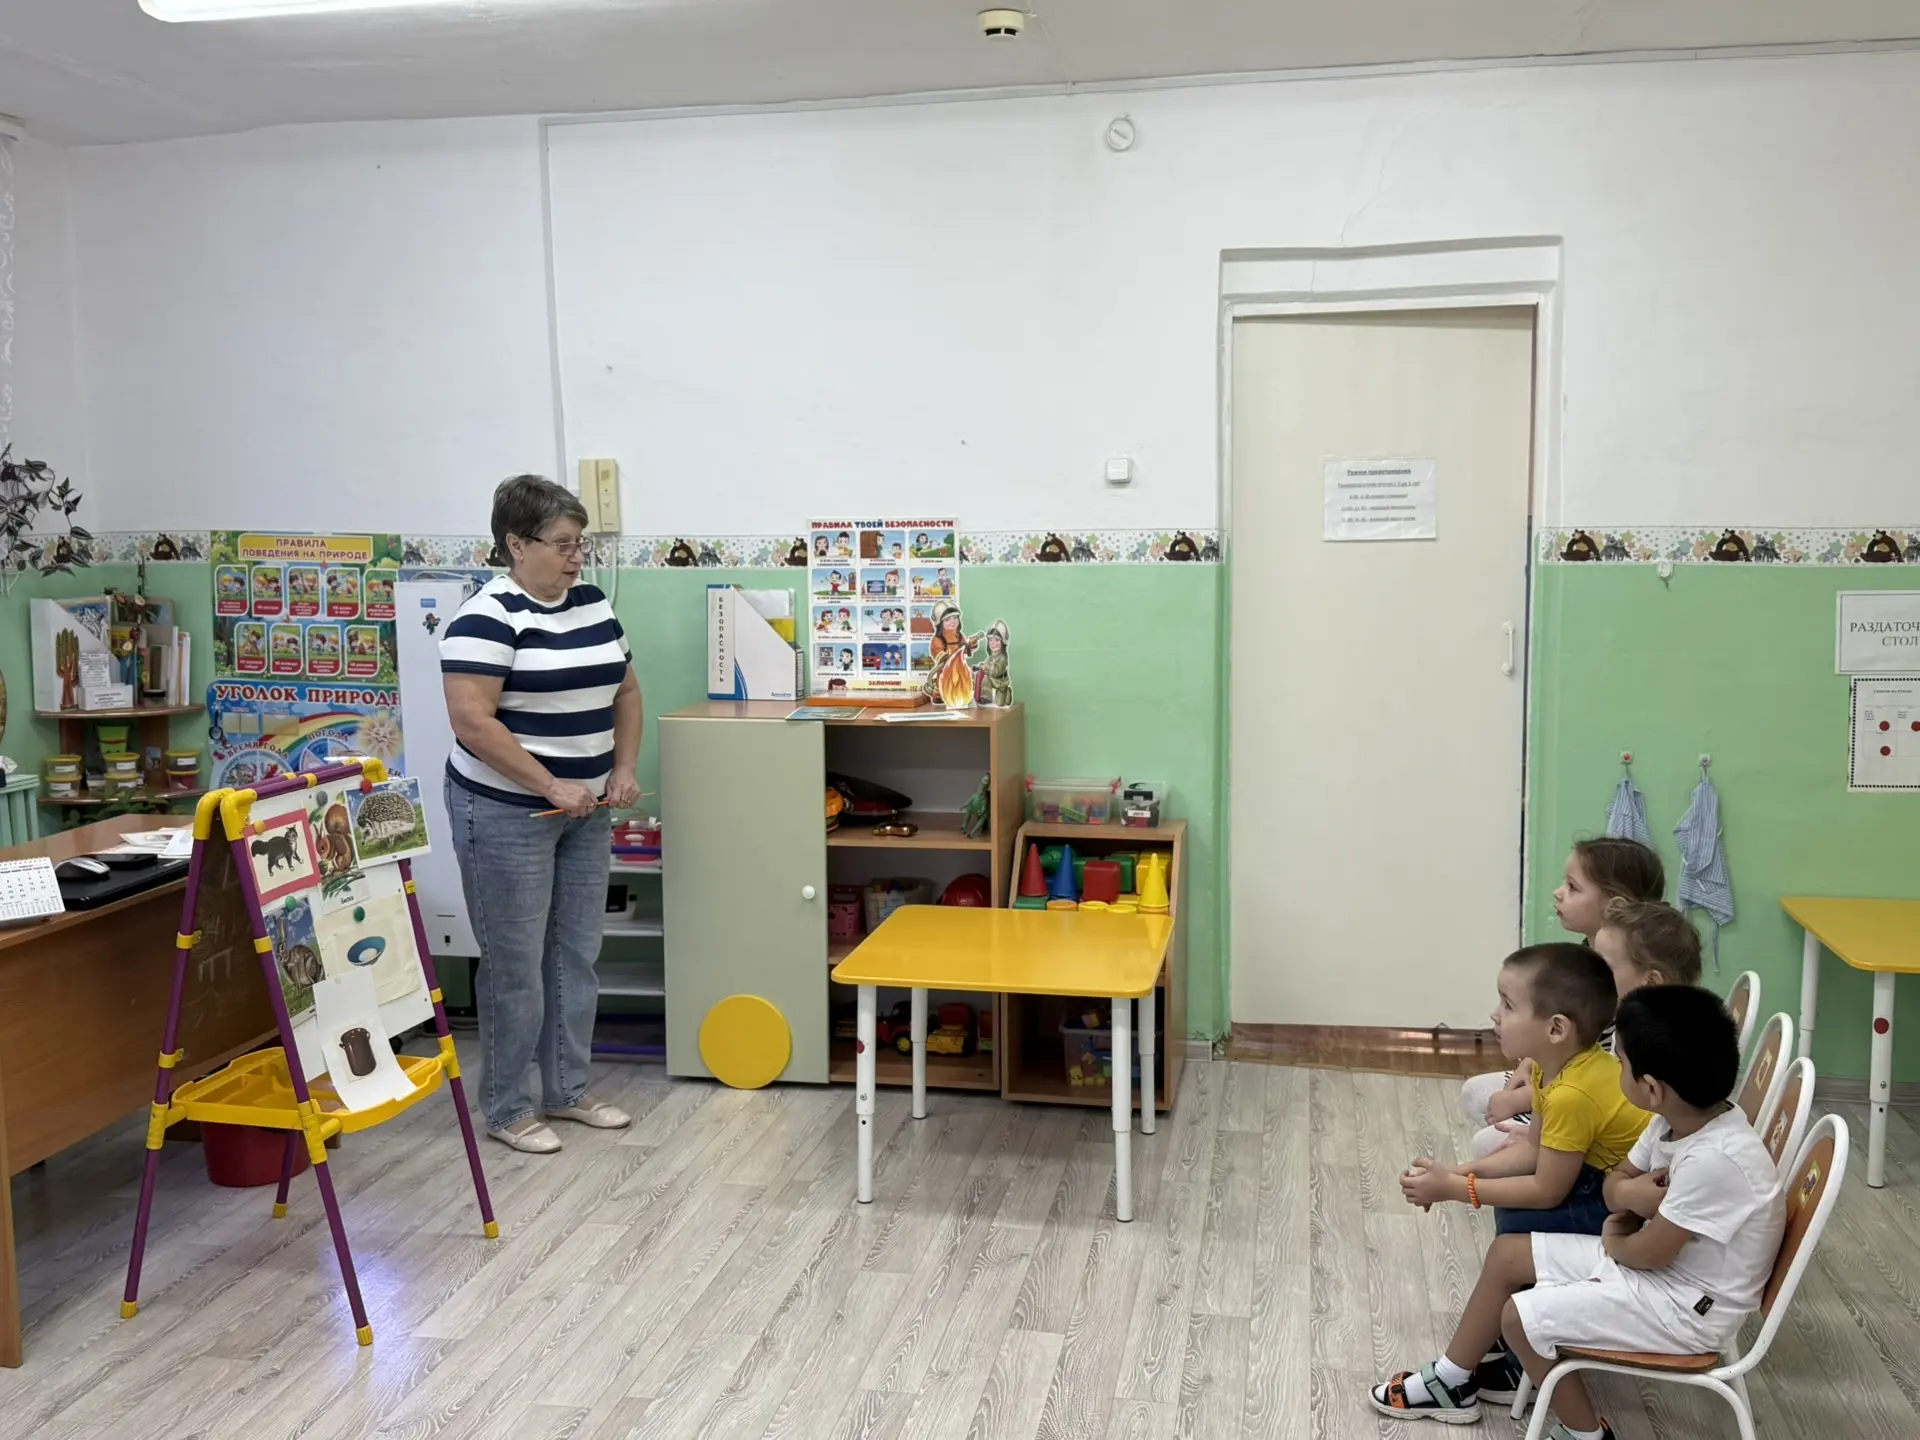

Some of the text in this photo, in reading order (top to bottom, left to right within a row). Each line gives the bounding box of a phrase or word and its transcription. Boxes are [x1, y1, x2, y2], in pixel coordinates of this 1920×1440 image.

[811, 519, 954, 529] ПРАВИЛА ТВОЕЙ БЕЗОПАСНОСТИ
[276, 538, 327, 548] ПРАВИЛА
[242, 549, 368, 560] ПОВЕДЕНИЯ НА ПРИРОДЕ
[1882, 636, 1919, 647] СТОЛ
[215, 685, 298, 702] УГОЛОК
[308, 729, 349, 742] ПОГОДА
[227, 742, 289, 760] ВРЕМЯ ГОДА
